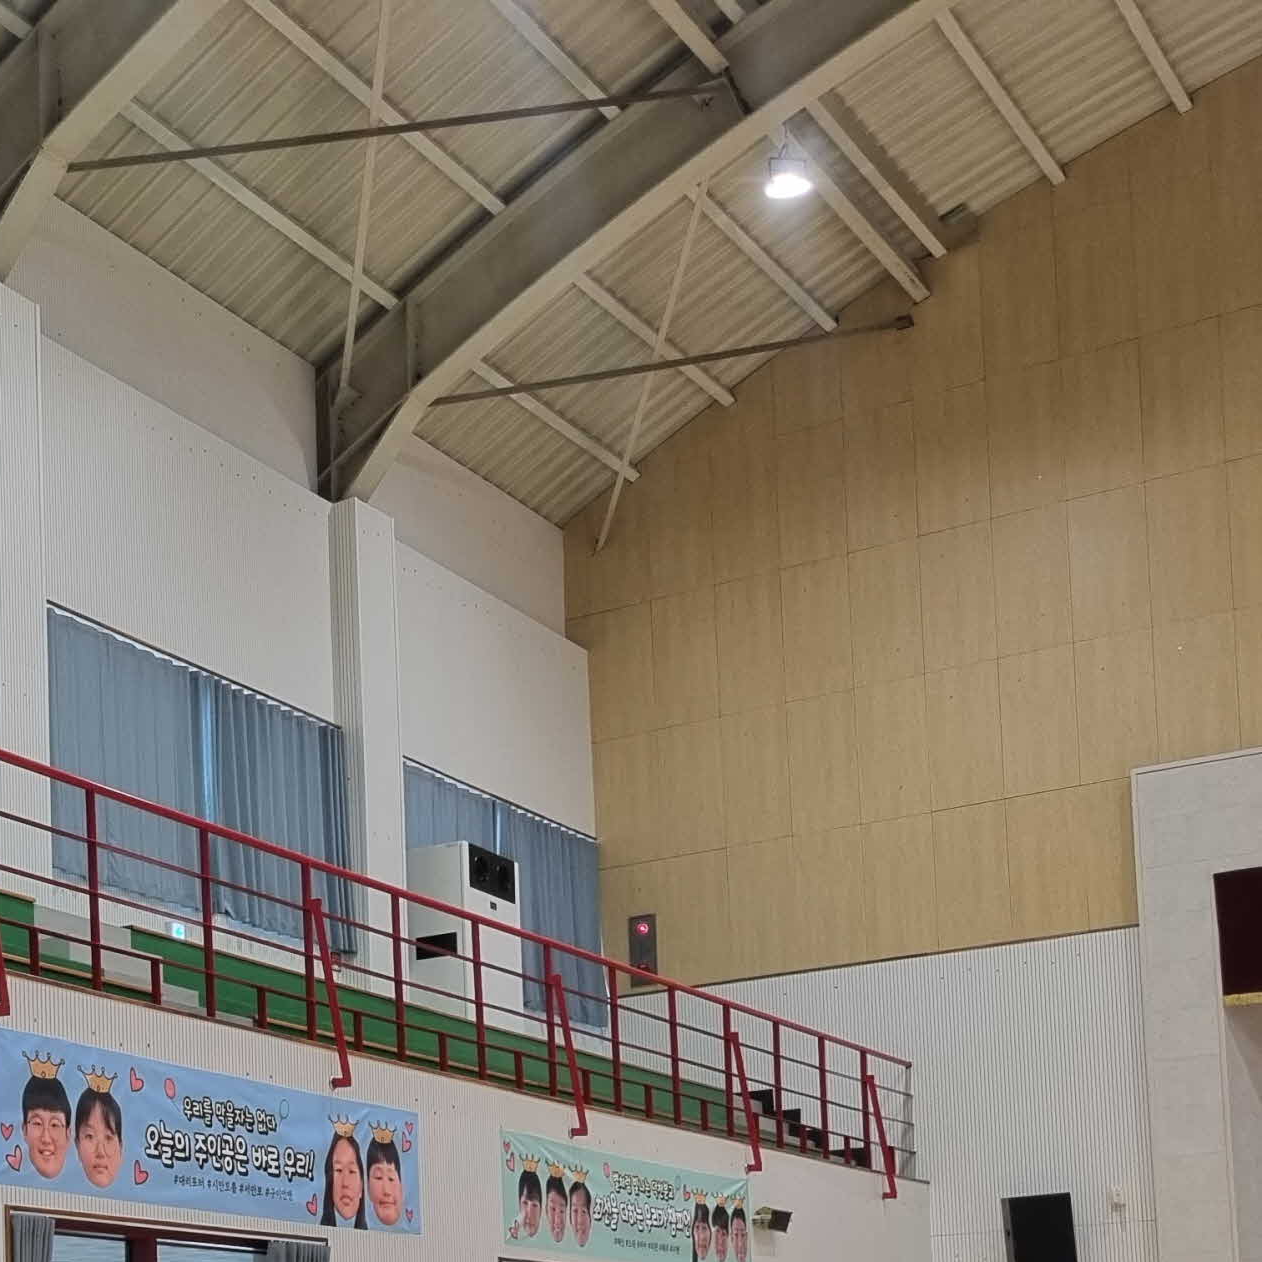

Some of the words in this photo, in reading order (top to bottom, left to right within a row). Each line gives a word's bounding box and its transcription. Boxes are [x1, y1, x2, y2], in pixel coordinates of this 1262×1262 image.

[183, 1096, 213, 1127] 우리를
[256, 1108, 277, 1136] 없다
[145, 1120, 190, 1169] 오늘의
[194, 1132, 248, 1176] 주인공은
[251, 1145, 281, 1178] 바로
[284, 1147, 315, 1183] 우리!
[619, 1199, 644, 1232] 다하는
[644, 1202, 667, 1233] 우리가
